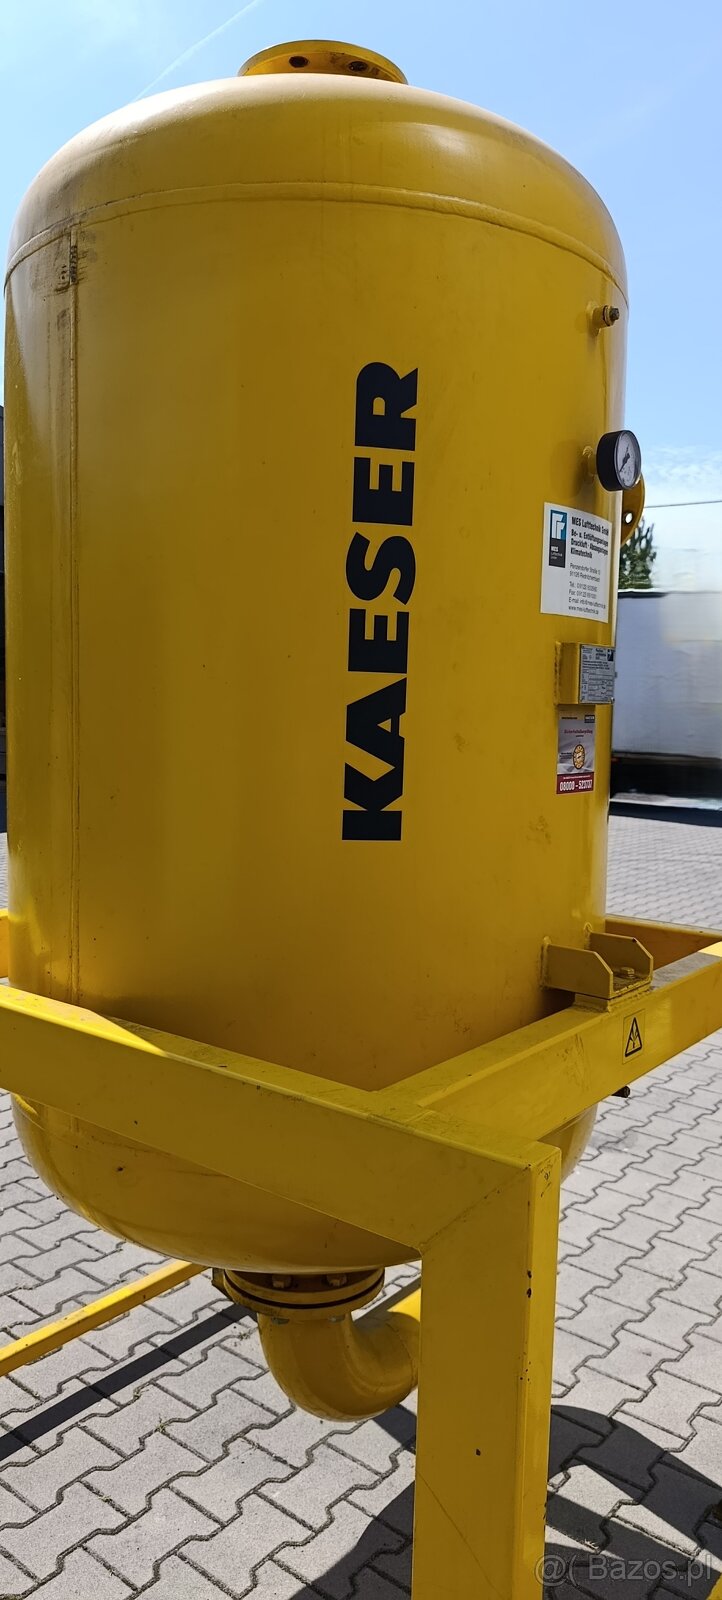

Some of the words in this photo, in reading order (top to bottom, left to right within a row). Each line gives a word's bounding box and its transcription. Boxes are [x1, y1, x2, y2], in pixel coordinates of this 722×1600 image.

[571, 516, 582, 527] MES
[342, 362, 418, 841] KAESER
[559, 781, 575, 792] 08000
